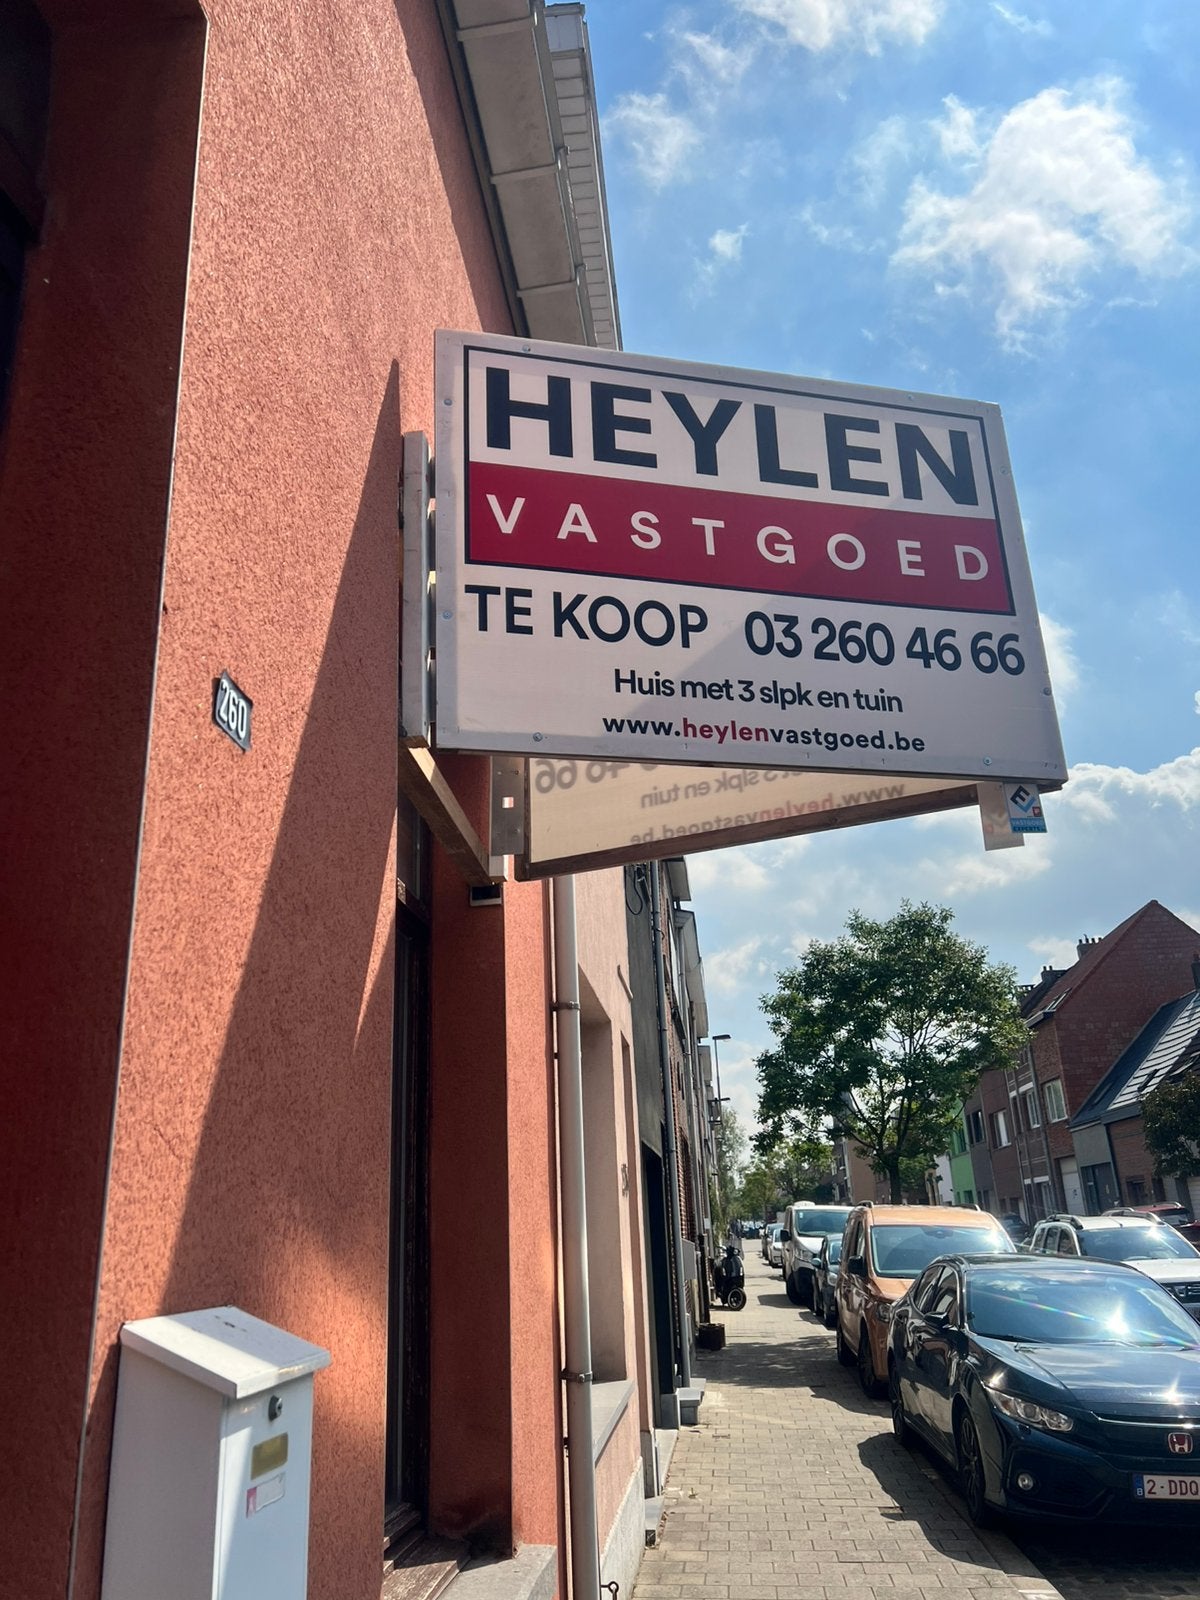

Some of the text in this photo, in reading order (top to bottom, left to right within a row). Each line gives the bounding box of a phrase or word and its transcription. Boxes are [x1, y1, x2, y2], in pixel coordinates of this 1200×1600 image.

[486, 367, 978, 506] HEYLEN
[486, 494, 989, 581] VASTGOED
[465, 585, 1025, 676] TE KOOP 03 260 46 66
[220, 679, 248, 740] 260
[614, 668, 903, 713] Huis met 3 slpk en tuin
[602, 717, 925, 751] www.heylenvastgoed.be
